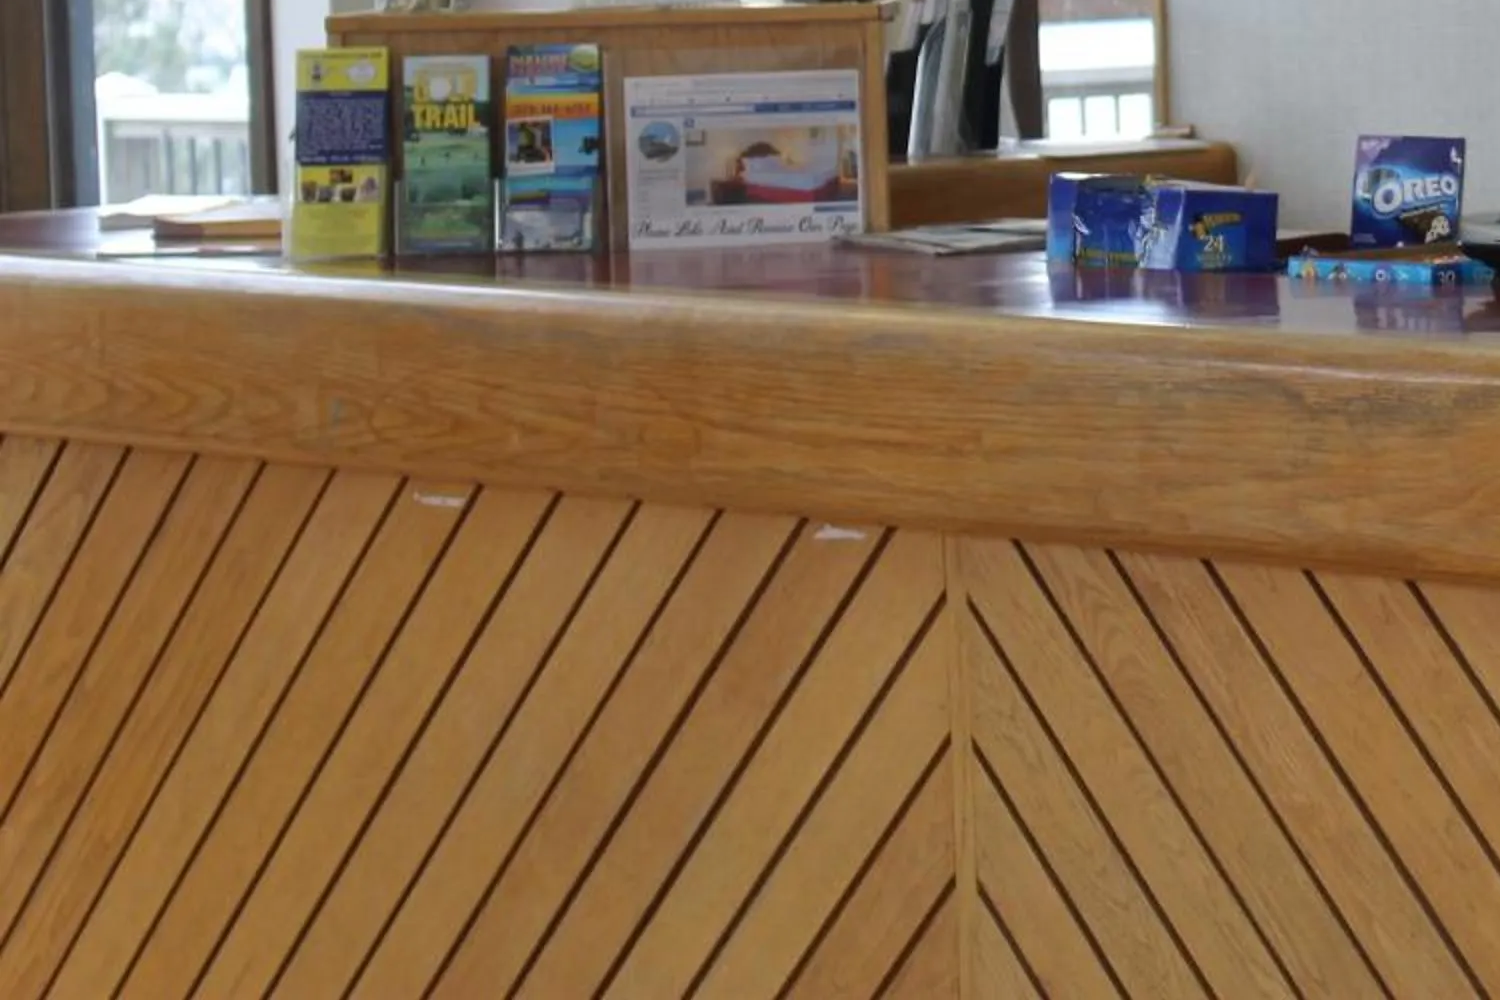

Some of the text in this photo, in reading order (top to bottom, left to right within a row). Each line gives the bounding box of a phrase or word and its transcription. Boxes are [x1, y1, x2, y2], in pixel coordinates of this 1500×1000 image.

[411, 103, 481, 129] TRAIL
[1373, 174, 1457, 214] OREO
[1203, 234, 1224, 253] 24
